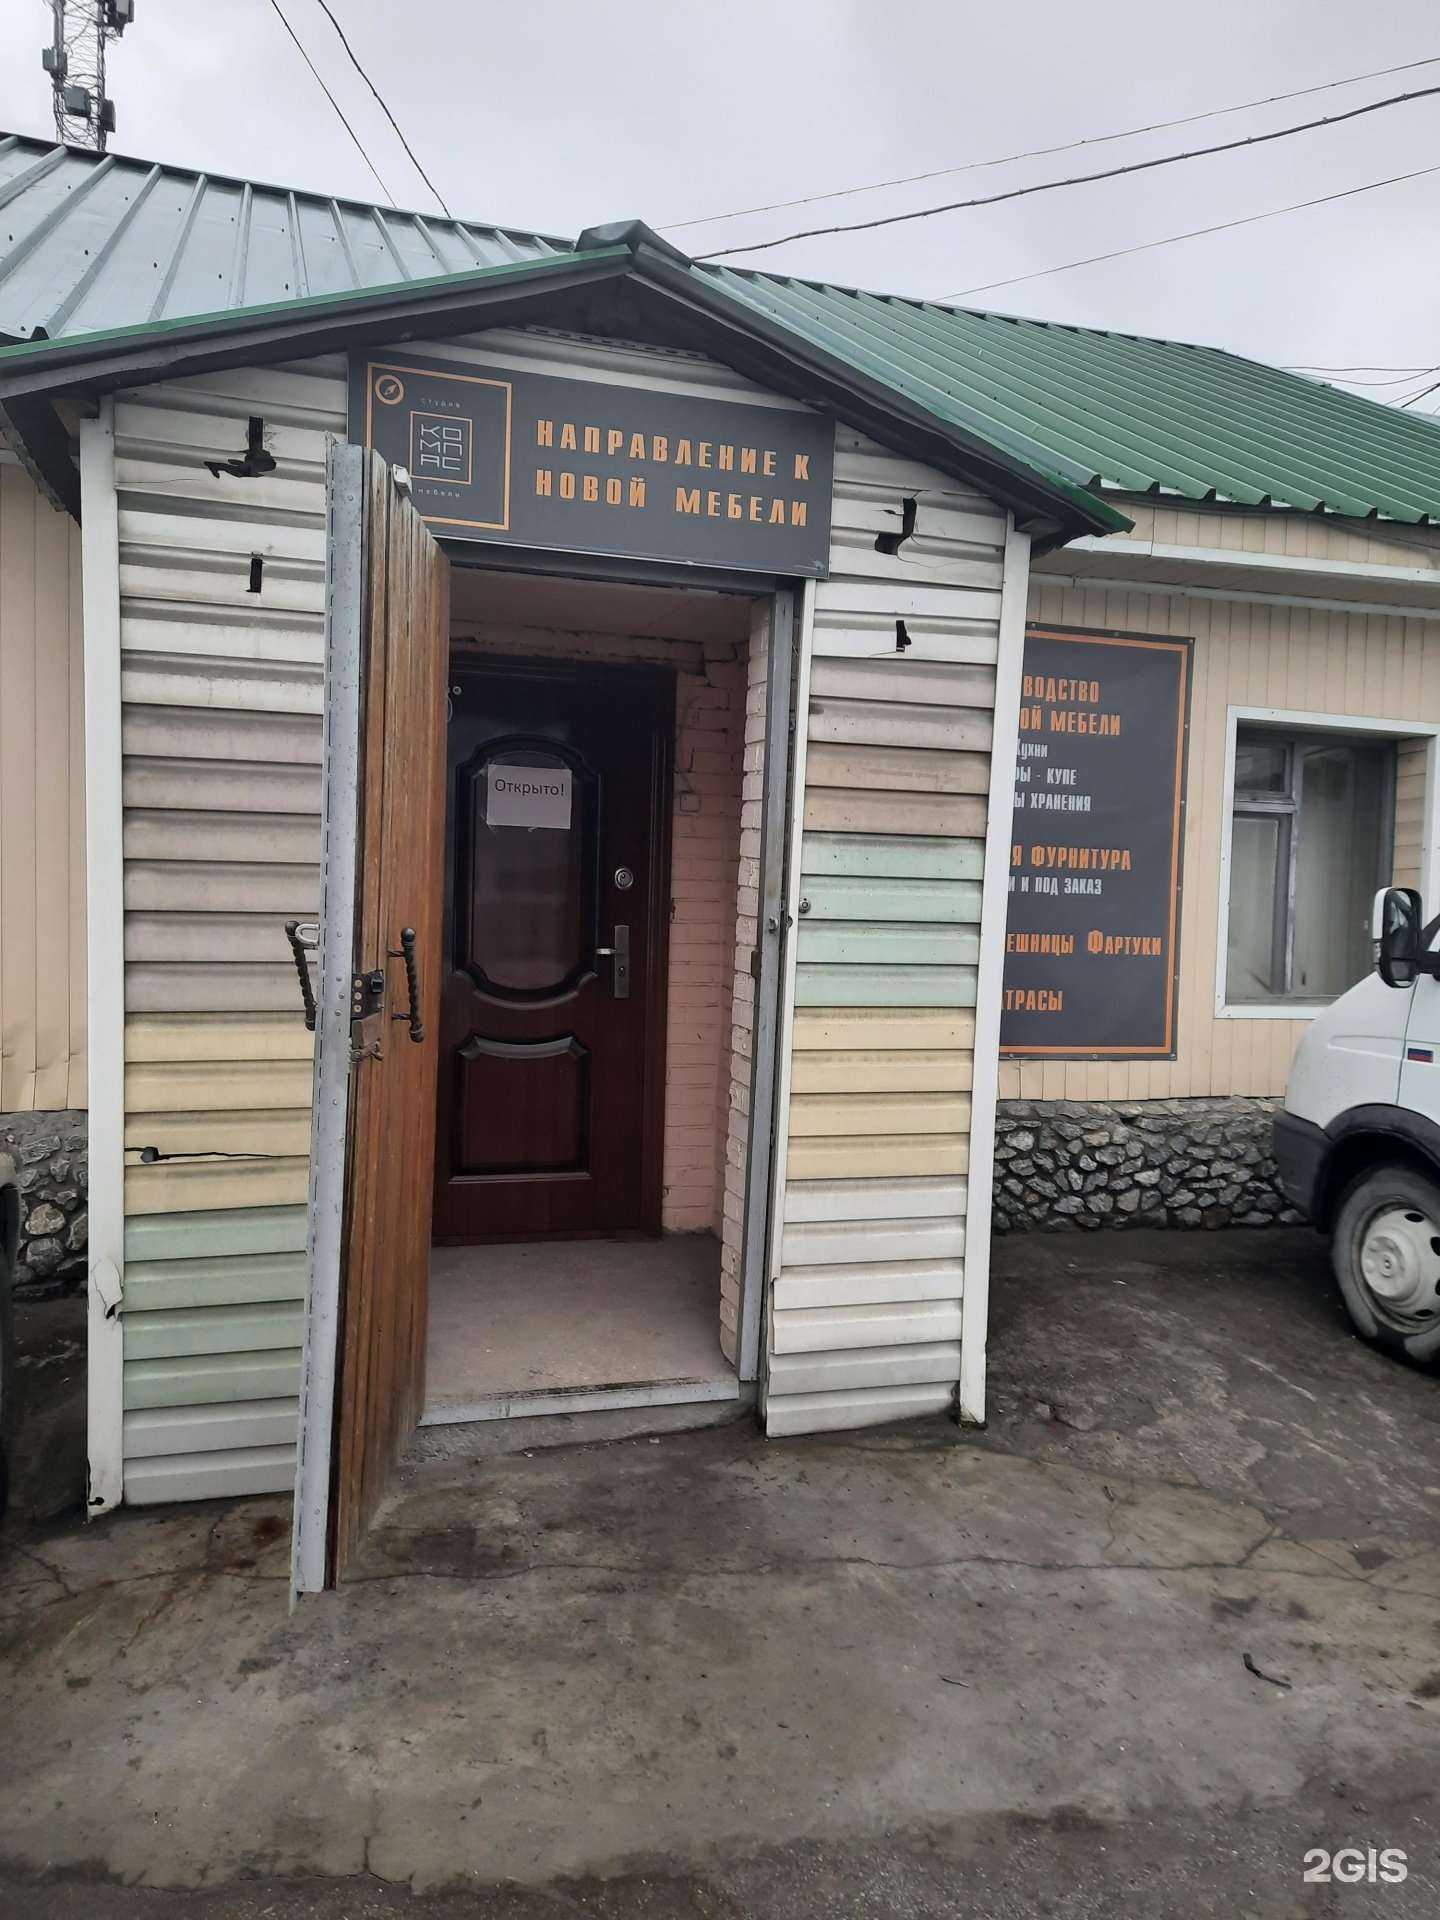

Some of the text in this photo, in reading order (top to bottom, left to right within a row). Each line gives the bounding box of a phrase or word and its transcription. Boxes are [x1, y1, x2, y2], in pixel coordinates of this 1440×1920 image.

[537, 419, 810, 481] НАПРАВЛЕНИЕ К
[535, 469, 808, 527] НОВОЙ МЕБЕЛИ
[1022, 675, 1100, 703] ВОДСТВО
[1050, 710, 1121, 736] МЕБЕЛИ
[494, 778, 565, 797] Открыто!
[1046, 767, 1078, 786] КУПЕ
[1030, 792, 1092, 812] ХРАНЕНИЯ
[1031, 845, 1132, 871] ФУРНИТУРА
[1021, 876, 1030, 893] И
[1035, 876, 1059, 896] ПОД
[1064, 877, 1103, 896] ЗАКАЗ
[1007, 933, 1075, 957] ЕШНИЦЫ
[1001, 987, 1064, 1012] ТРАСЫ
